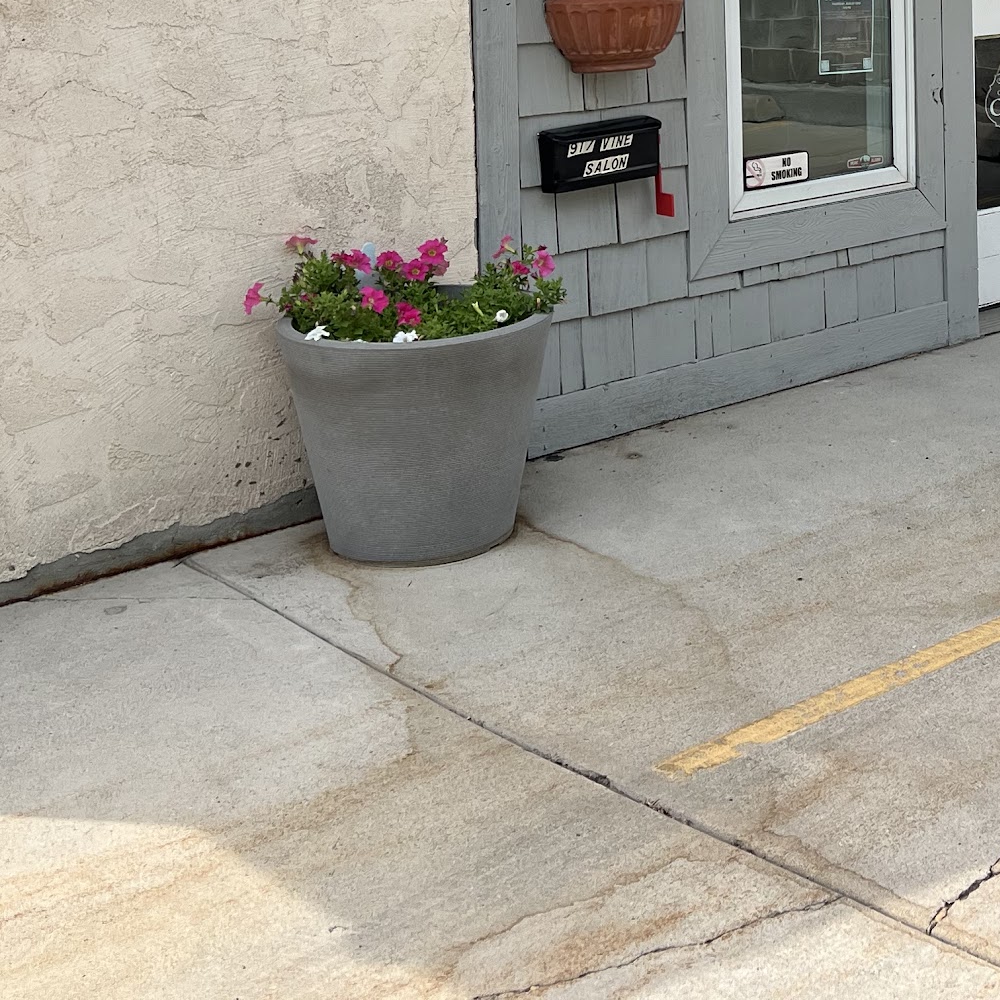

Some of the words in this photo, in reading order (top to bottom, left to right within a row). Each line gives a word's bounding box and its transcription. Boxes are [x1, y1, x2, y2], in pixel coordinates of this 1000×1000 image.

[569, 140, 595, 155] 917
[602, 134, 633, 149] VINE
[585, 156, 627, 176] SALON
[781, 157, 791, 168] NO
[770, 167, 803, 181] SMOKING
